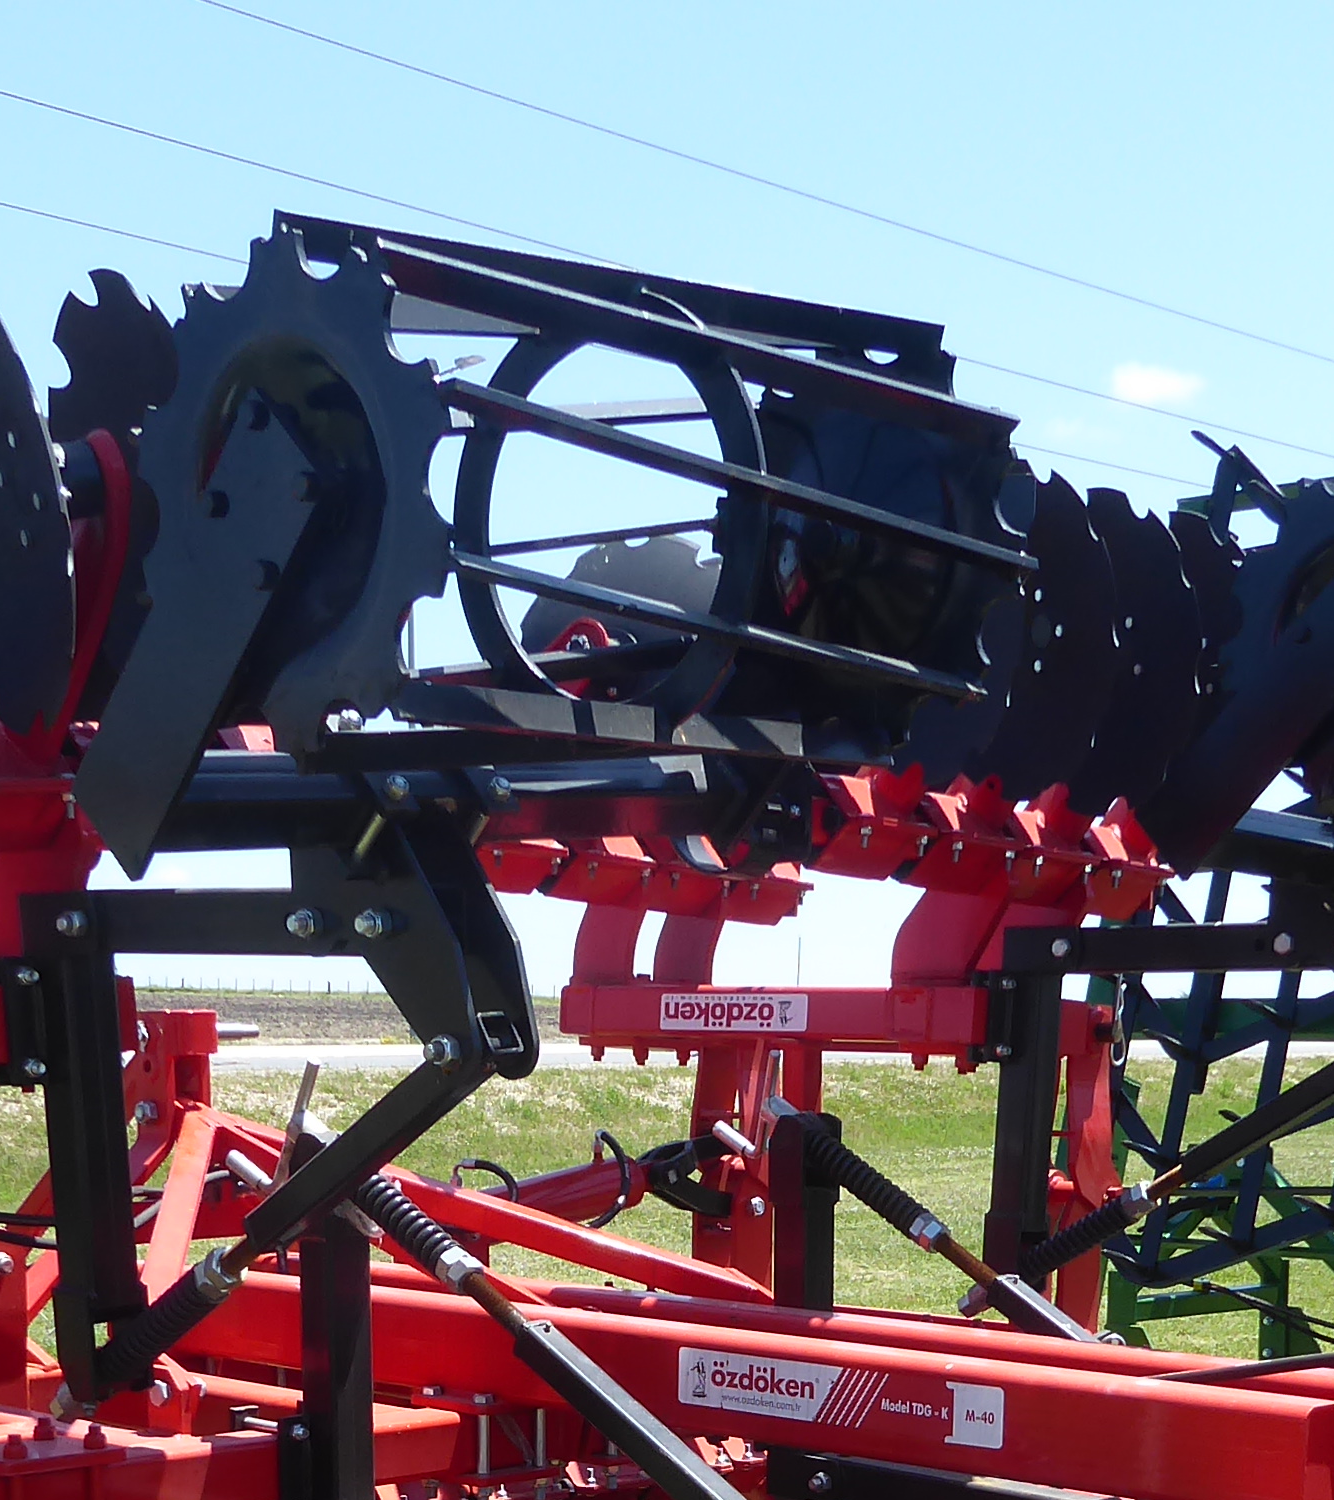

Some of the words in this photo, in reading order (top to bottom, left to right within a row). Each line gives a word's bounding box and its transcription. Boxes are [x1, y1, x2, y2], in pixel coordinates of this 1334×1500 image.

[665, 1002, 774, 1028] özdöken
[711, 1360, 814, 1400] özdöken
[881, 1397, 910, 1414] Model
[912, 1402, 932, 1417] TDG
[942, 1406, 949, 1420] K
[965, 1409, 995, 1425] M-40
